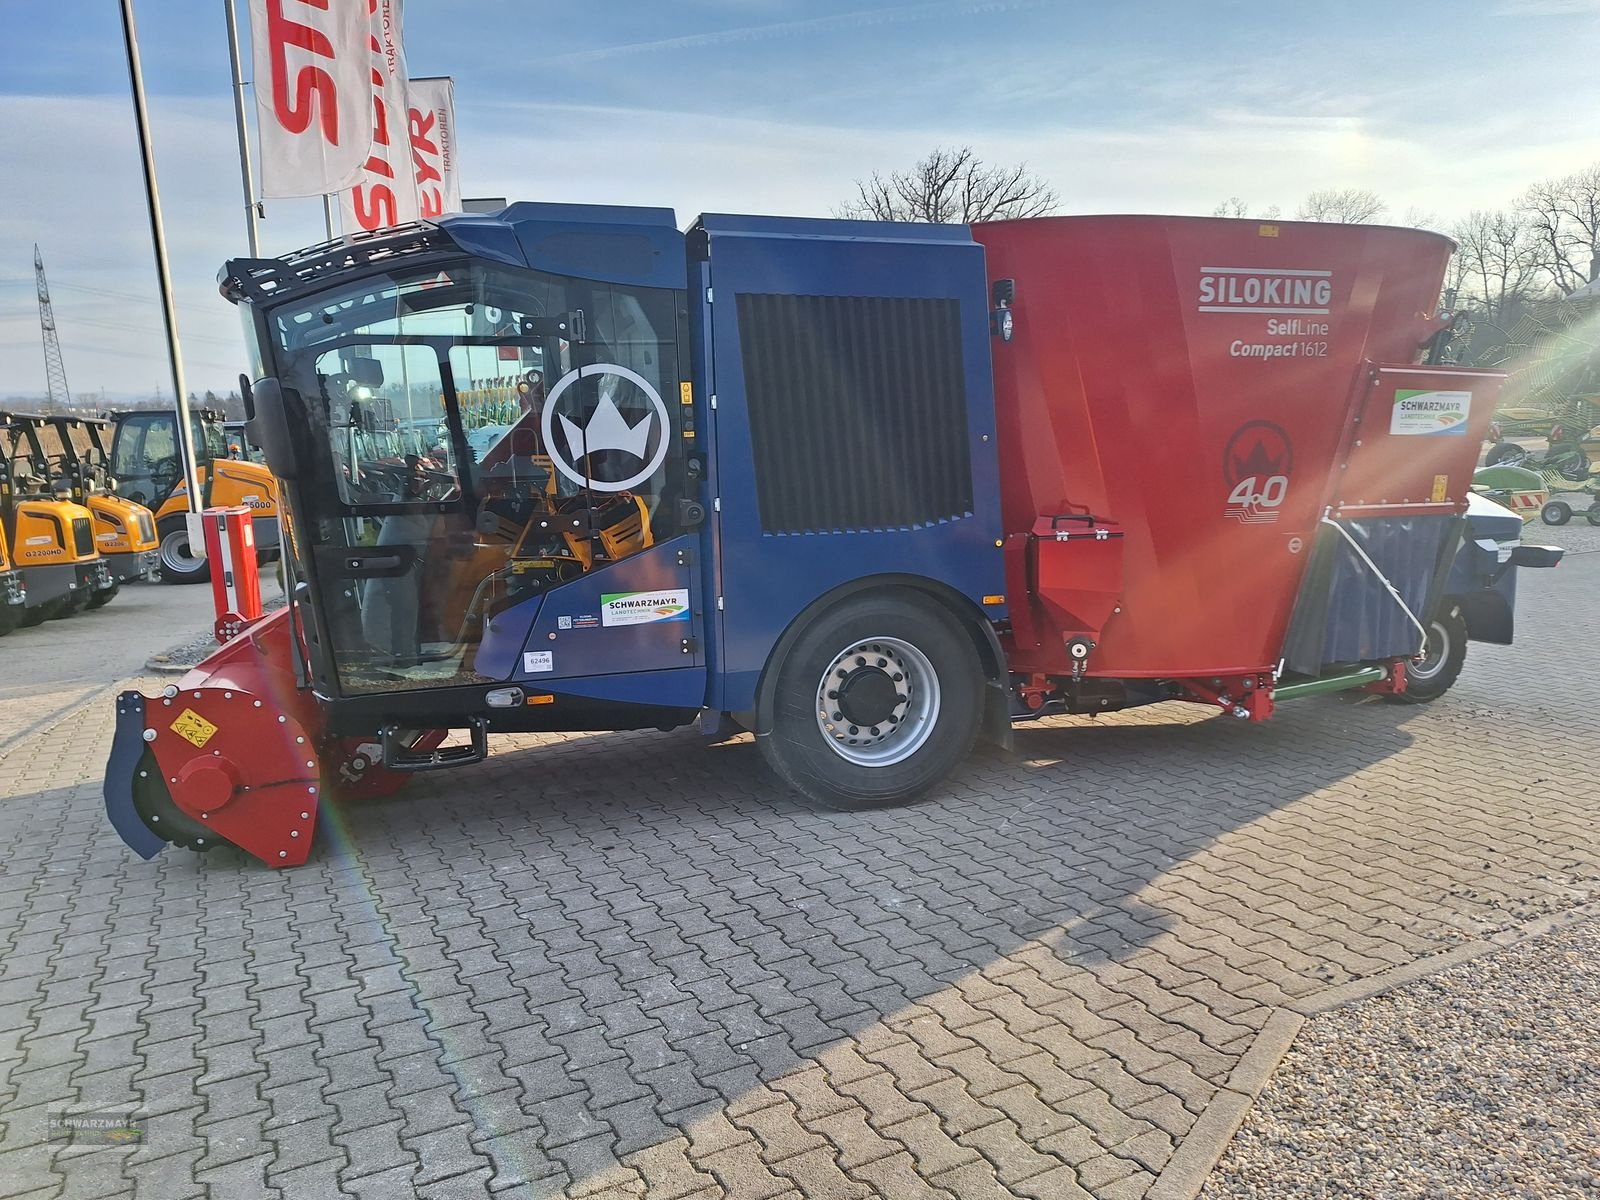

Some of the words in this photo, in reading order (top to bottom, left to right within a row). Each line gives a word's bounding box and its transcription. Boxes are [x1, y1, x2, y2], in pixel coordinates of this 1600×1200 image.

[382, 0, 396, 76] TRAKTORE
[265, 0, 339, 146] ST
[439, 108, 451, 173] TRAKTOREN
[407, 107, 442, 218] EYR
[1199, 276, 1332, 305] SILOKING
[1266, 318, 1329, 336] SelfLine
[1230, 340, 1298, 360] Compact
[1301, 341, 1328, 357] 1612
[1400, 400, 1461, 411] SCHWARZMAYR
[609, 597, 677, 610] SCHWARZMAYR
[530, 657, 550, 665] 62496
